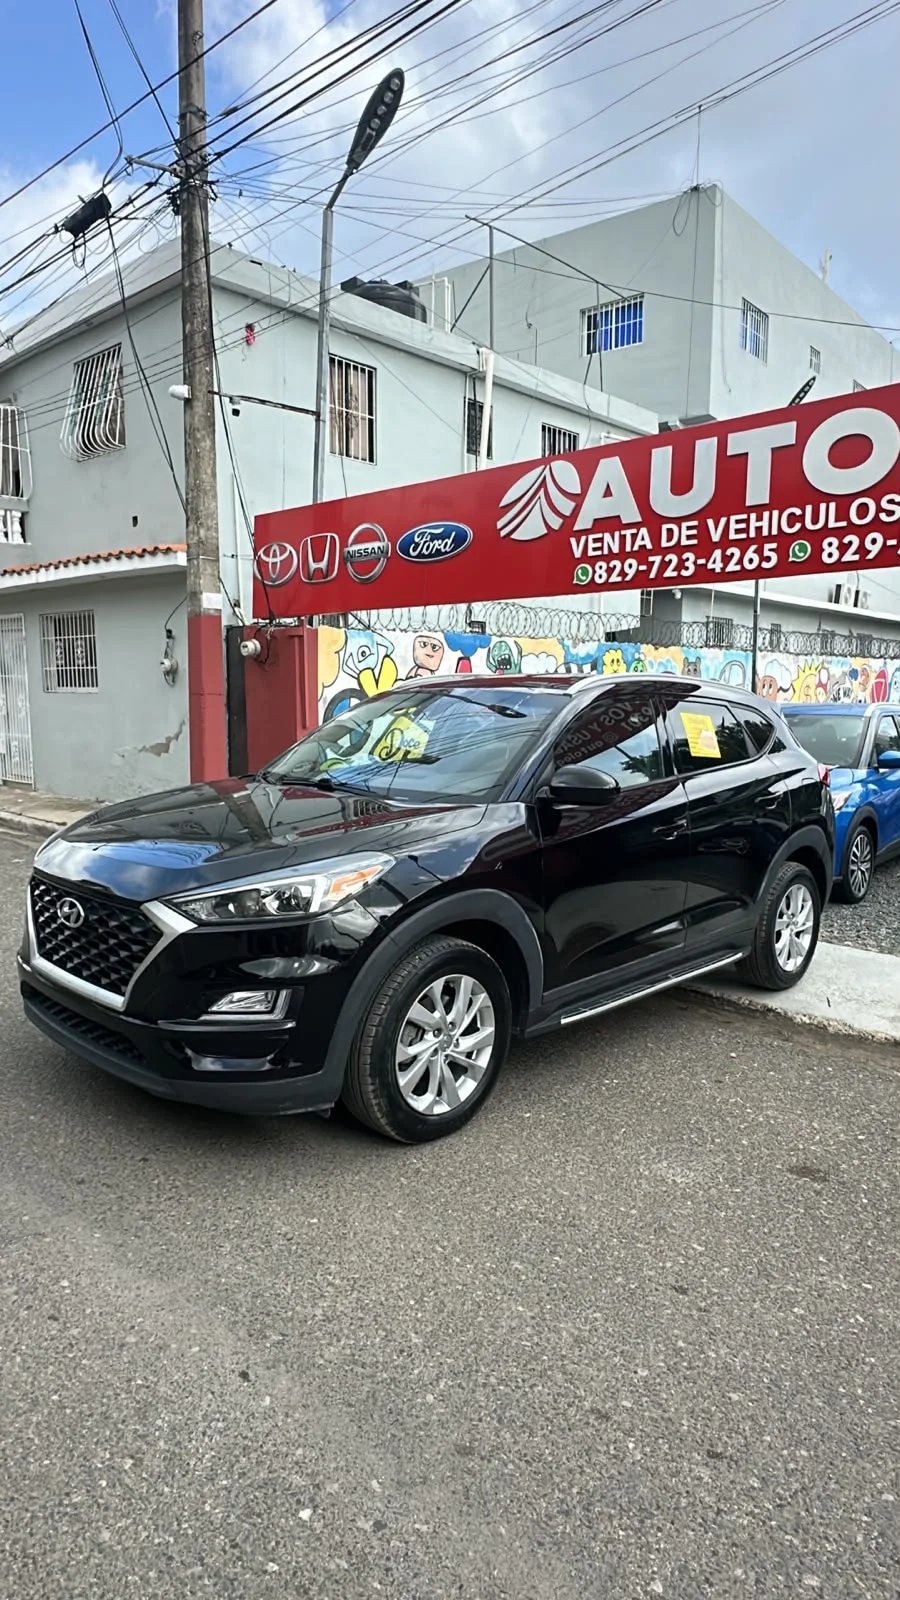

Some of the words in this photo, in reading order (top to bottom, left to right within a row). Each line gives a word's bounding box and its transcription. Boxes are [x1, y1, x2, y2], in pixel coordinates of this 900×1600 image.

[573, 407, 900, 531] AUTO
[346, 545, 385, 558] NISSAN
[409, 527, 454, 557] Ford
[570, 527, 653, 558] VENTA
[661, 520, 698, 548] DE
[706, 493, 900, 543] VEHICULOS
[594, 543, 778, 584] 829-723-4265
[821, 531, 900, 564] 829-
